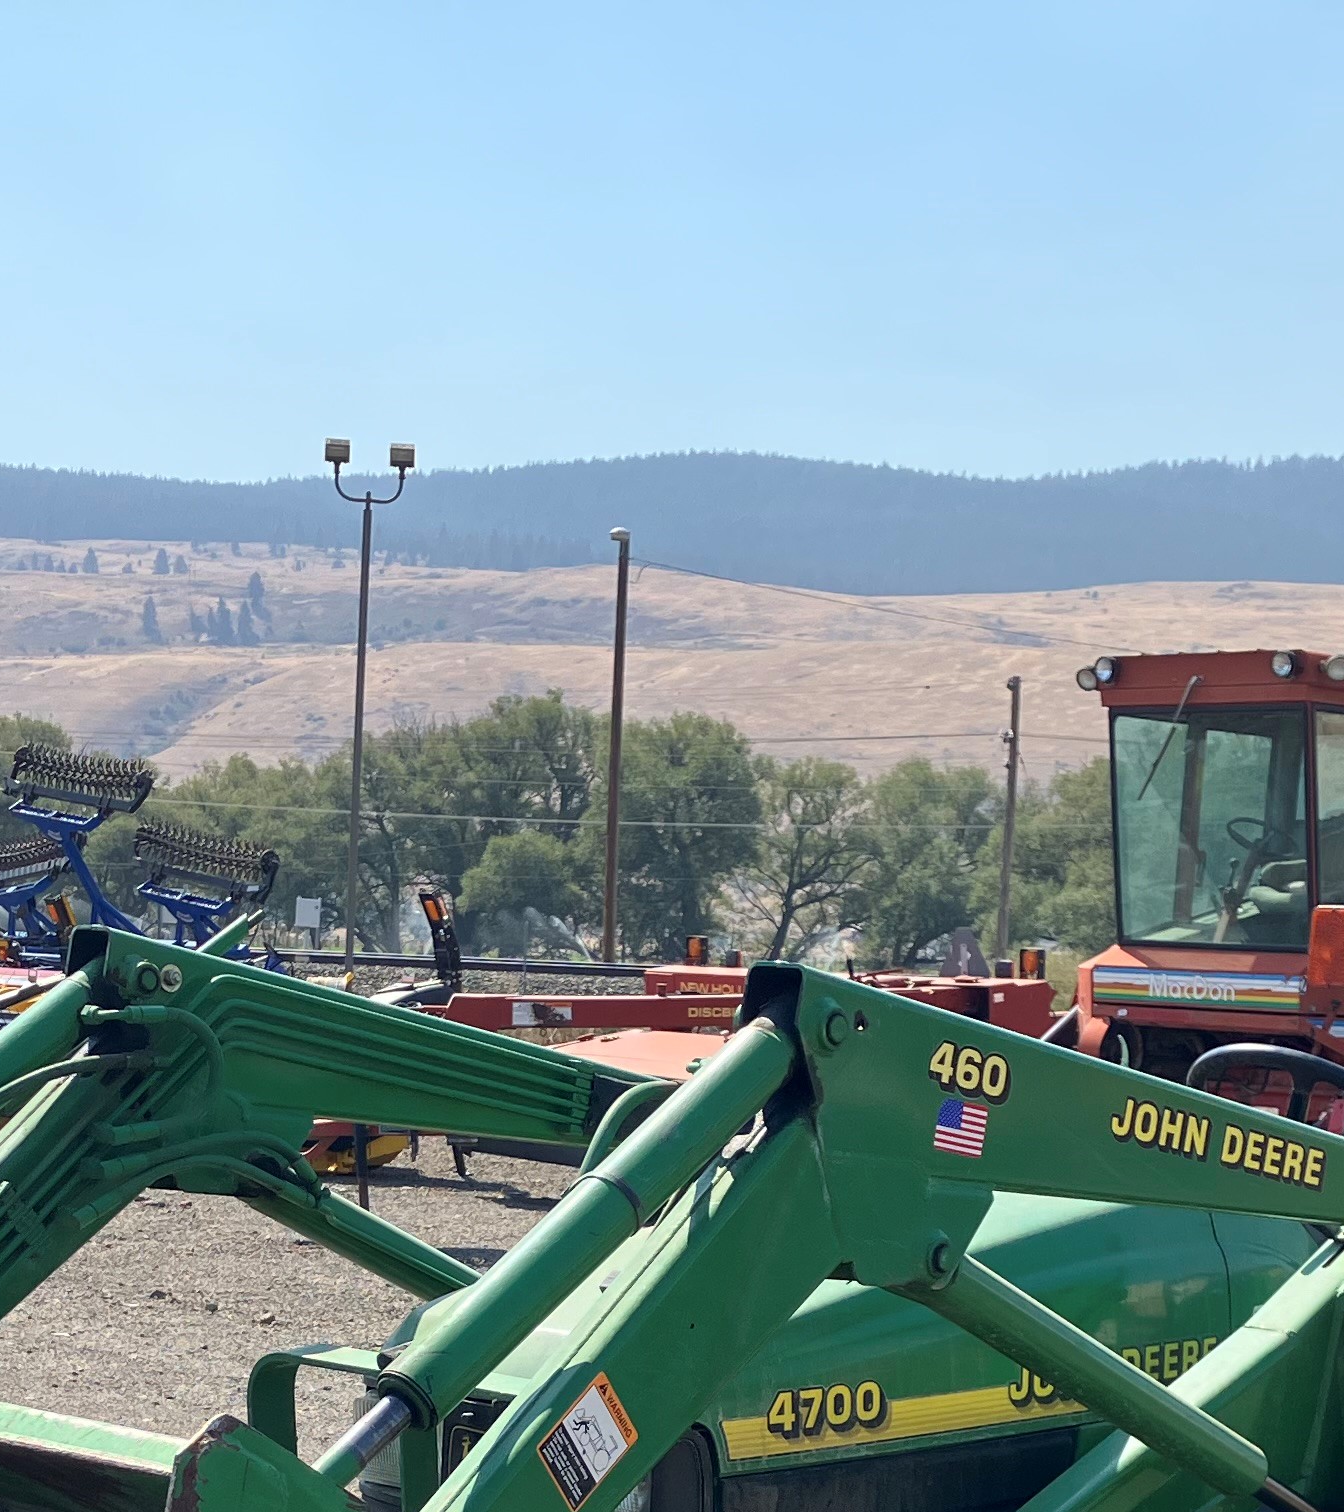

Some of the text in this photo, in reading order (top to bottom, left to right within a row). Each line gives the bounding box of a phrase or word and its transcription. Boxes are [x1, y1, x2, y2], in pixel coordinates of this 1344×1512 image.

[679, 981, 742, 995] NEW HOLL
[1148, 973, 1236, 1003] MacDon
[687, 1006, 736, 1018] DISCB
[929, 1041, 1010, 1103] 460
[1110, 1097, 1329, 1190] JOHN DEERE
[607, 1395, 634, 1439] WARNING
[768, 1380, 886, 1438] 4700
